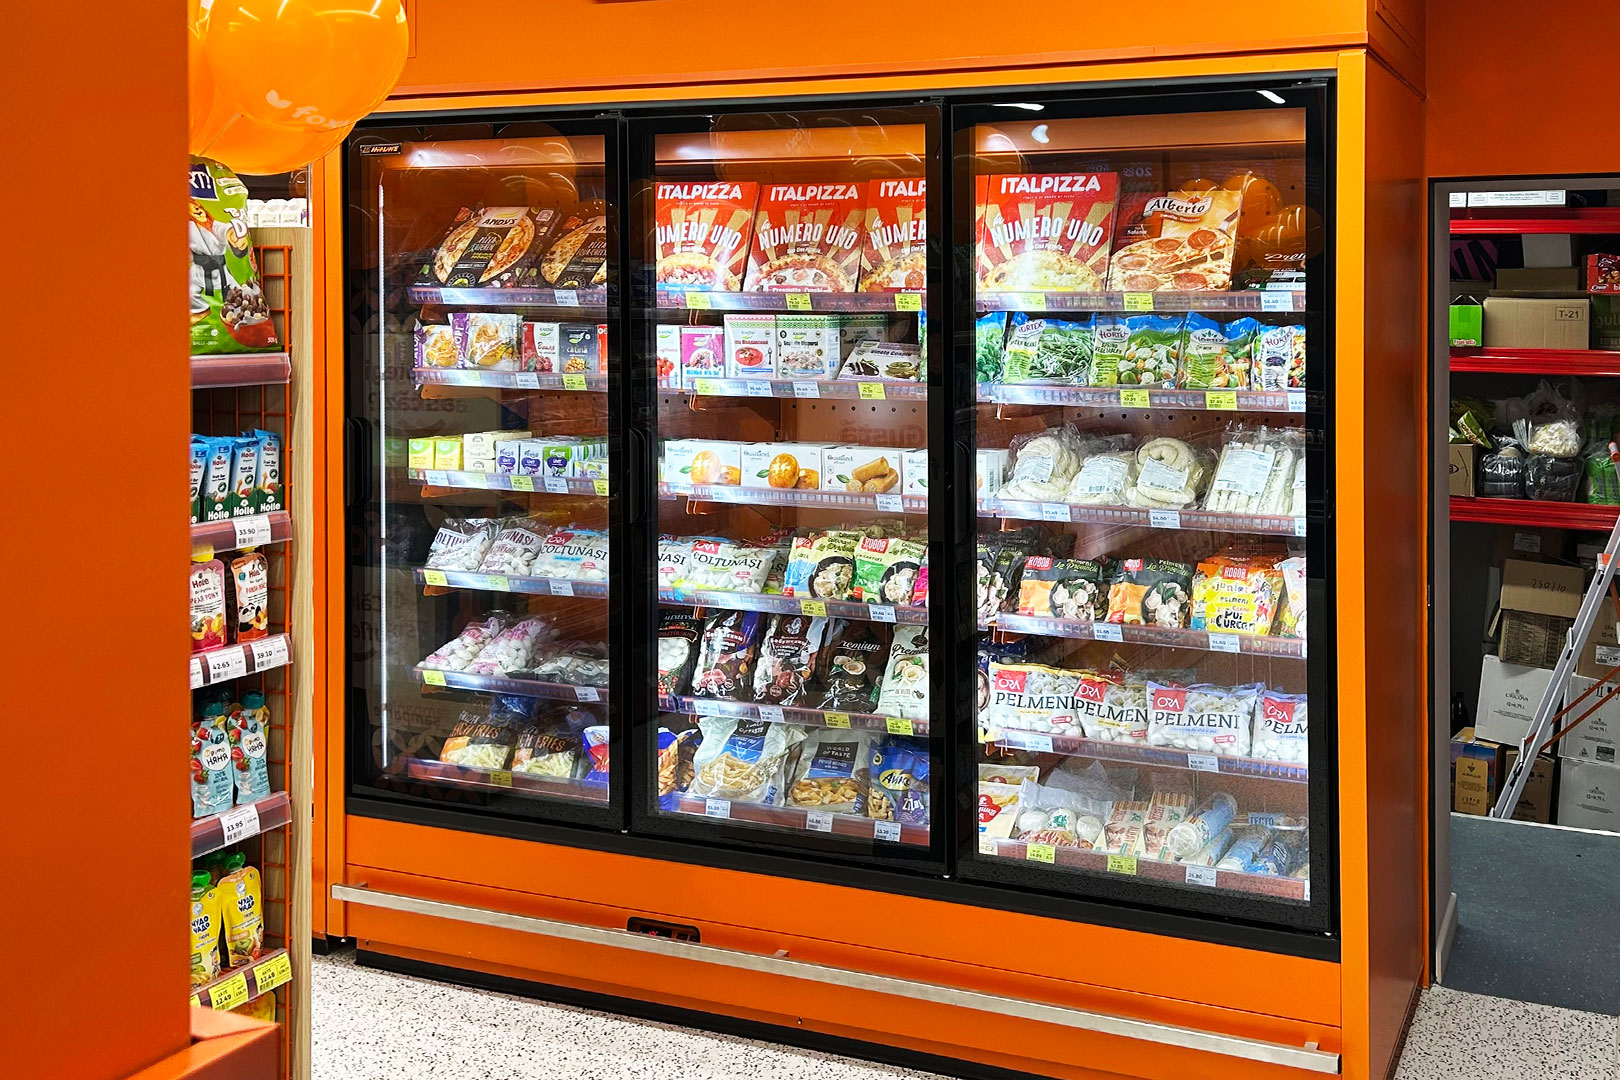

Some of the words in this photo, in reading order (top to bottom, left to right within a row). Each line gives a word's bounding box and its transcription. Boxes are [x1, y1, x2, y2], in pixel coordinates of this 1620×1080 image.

[657, 184, 742, 200] ITALPIZZA
[1000, 175, 1101, 195] ITALPIZZA
[770, 185, 858, 201] ITALPIZZA
[1150, 199, 1206, 214] Alberto
[710, 224, 742, 251] UNO
[758, 221, 823, 251] NUMERO
[825, 225, 858, 250] UNO
[990, 216, 1064, 248] NUMERO
[1067, 218, 1104, 247] UNO
[1560, 311, 1579, 319] T-21
[233, 506, 255, 516] Holle
[260, 502, 281, 512] Holle
[208, 510, 230, 521] Holle
[239, 528, 256, 536] 33.90
[212, 661, 230, 670] 42.65
[998, 678, 1021, 690] ORA
[1078, 683, 1100, 699] ORA
[995, 692, 1076, 710] PELMENI
[1157, 697, 1180, 709] ORA
[1155, 711, 1240, 730] PELMENI
[206, 754, 229, 767] НЯНЯ
[227, 821, 243, 833] 13.95
